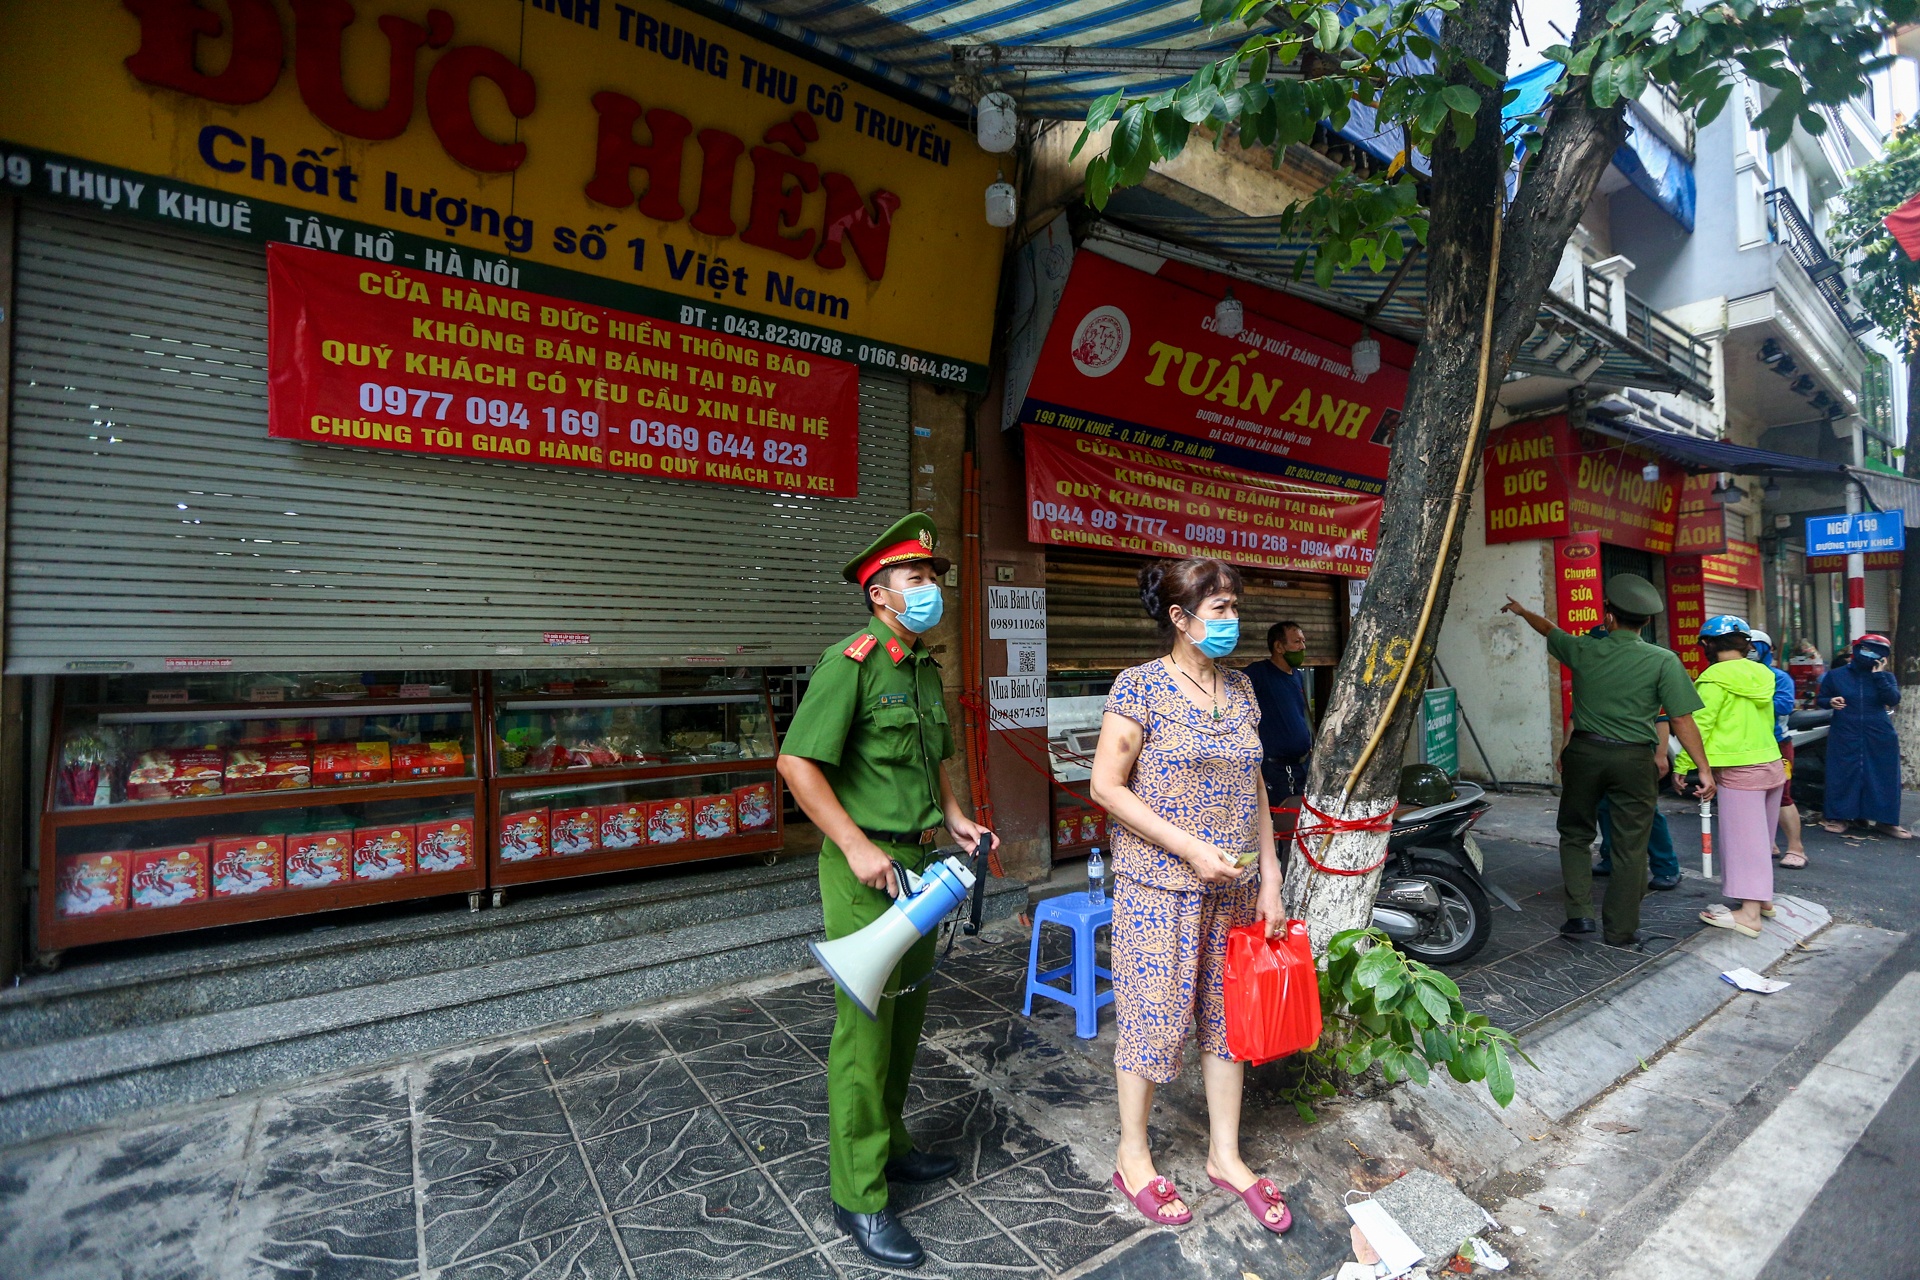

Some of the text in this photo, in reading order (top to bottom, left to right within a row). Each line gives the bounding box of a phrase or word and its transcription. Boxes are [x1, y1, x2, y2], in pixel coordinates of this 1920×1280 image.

[615, 4, 728, 79] TRUNG
[740, 54, 797, 104] THU
[807, 80, 849, 123] CỔ
[855, 101, 951, 167] TRUYỀN
[585, 91, 900, 281] HIỀN
[44, 162, 145, 210] THỤY
[158, 189, 252, 233] KHUÊ
[285, 215, 344, 251] TÂY
[354, 230, 395, 262] HỒ
[425, 247, 464, 278] HÀ
[199, 125, 850, 320] Chất lượng số 1 Việt Nam
[359, 270, 811, 378] CỬA HÀNG ĐỨC HIỀN THÔNG BÁO
[680, 304, 968, 383] ĐT 043.8230798 0166.9644.823
[412, 317, 777, 399] KHÔNG BÁN BÁNH TẠI ĐÂY
[1320, 358, 1352, 378] TRUNG
[321, 339, 830, 439] QUÝ KHÁCH CÓ YÊU CẦU XIN LIÊN HỆ
[1144, 340, 1371, 439] TUẤN ANH
[359, 382, 808, 468] 0977 094 169 0369 644 823
[1034, 409, 1056, 425] 199
[1057, 413, 1086, 432] THỤY
[1085, 421, 1115, 437] KHUÊ
[1133, 430, 1151, 446] TÂY
[1185, 441, 1199, 455] HÀ
[311, 415, 835, 492] CHÚNG TÔI GIAO HÀNG CHO QUÝ KHÁCH TẠI XE!
[1076, 438, 1123, 459] CỬA
[1128, 448, 1186, 472] HÀNG
[1495, 435, 1554, 466] VÀNG
[1115, 468, 1335, 519] KHÔNG BÁN BÁNH TẠI ĐÂY
[1503, 468, 1548, 496] ĐỨC
[1577, 452, 1616, 497] ĐỨC
[1032, 500, 1084, 526] 0944
[1091, 509, 1118, 530] 98
[1122, 513, 1168, 537] 7777
[1185, 523, 1226, 545] 0989
[1231, 530, 1258, 549] 110
[1262, 534, 1288, 553] 268
[1301, 540, 1331, 558] 0984
[1334, 544, 1357, 560] 874
[1056, 480, 1368, 543] QUÝ KHÁCH CÓ YÊU CẦU XIN LIÊN HỆ
[1490, 500, 1565, 530] HOÀNG
[1857, 518, 1878, 532] 199
[1050, 526, 1114, 547] CHÚNG
[1119, 535, 1146, 550] TÔI
[1152, 540, 1187, 556] GIAO
[1191, 546, 1232, 561] HÀNG
[1236, 552, 1262, 565] CHO
[1267, 555, 1290, 568] QUÝ
[1293, 558, 1334, 572] KHÁCH
[1336, 562, 1352, 574] TẠI
[1871, 536, 1894, 546] KHUÊ
[1564, 567, 1597, 579] Chuyên
[1570, 584, 1594, 601] SỬA
[990, 589, 1045, 615] Mua Bánh Gọi
[990, 618, 1045, 630] 0989110268
[1568, 607, 1598, 622] CHỮA
[1676, 600, 1699, 612] MUA
[1678, 616, 1700, 629] BÁN
[990, 678, 1046, 703] Mua Bánh Gọi
[991, 706, 1046, 720] 0984874752
